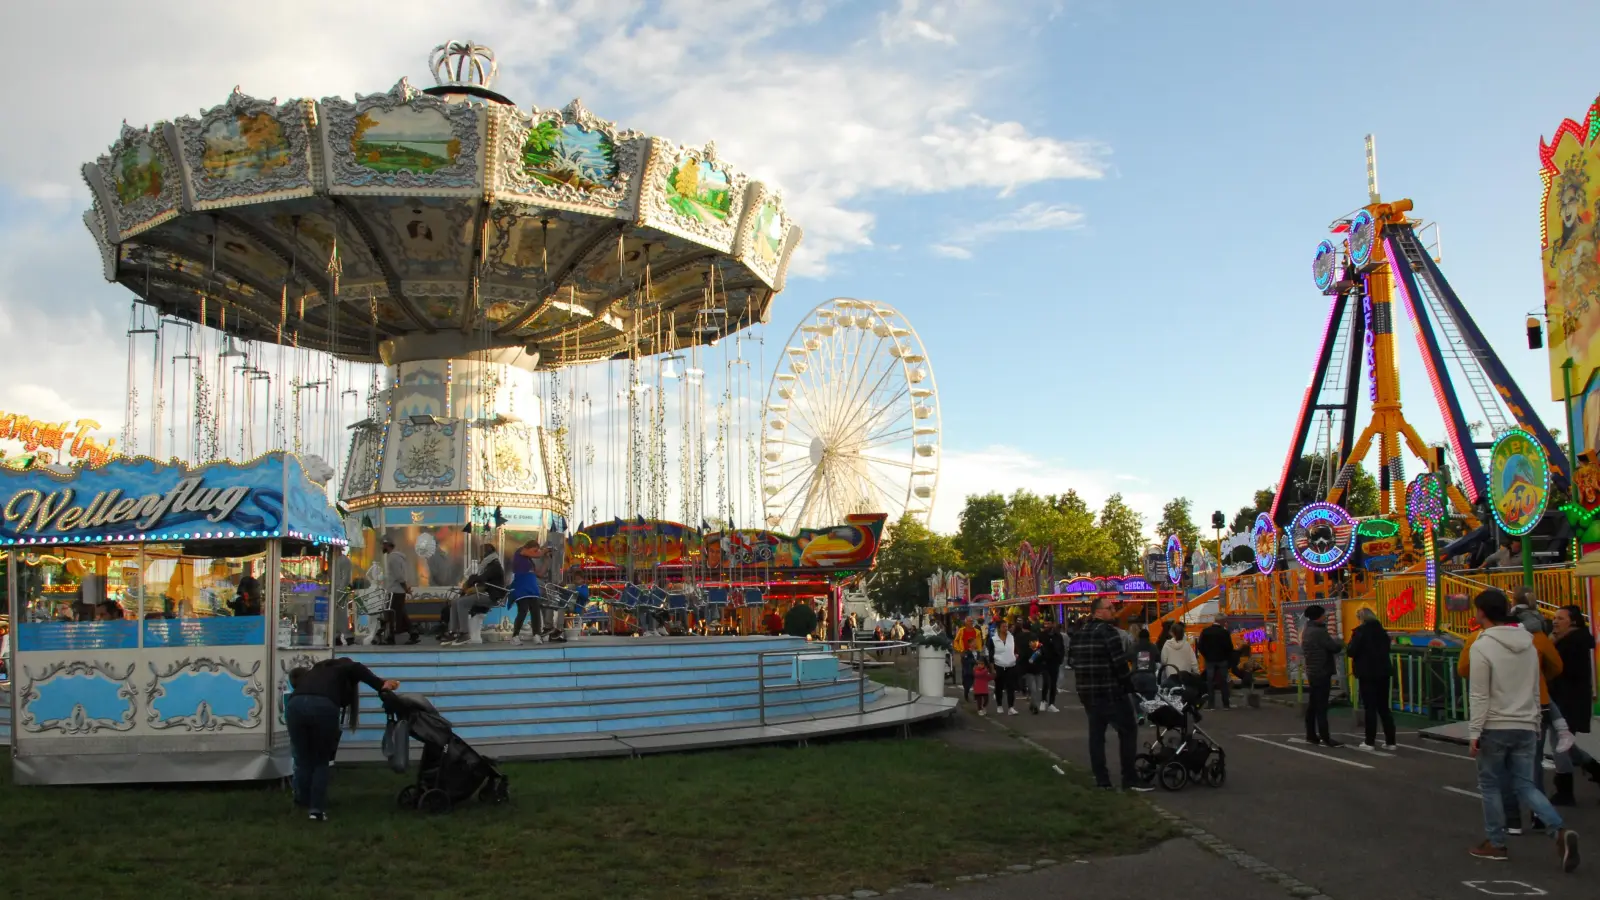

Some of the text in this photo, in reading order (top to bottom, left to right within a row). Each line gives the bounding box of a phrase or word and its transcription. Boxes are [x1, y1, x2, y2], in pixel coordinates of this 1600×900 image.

[1361, 273, 1378, 401] IRFORCE
[3, 477, 250, 533] Wellenflug
[1301, 508, 1340, 526] AIRFORCE
[1124, 580, 1145, 590] CHECK
